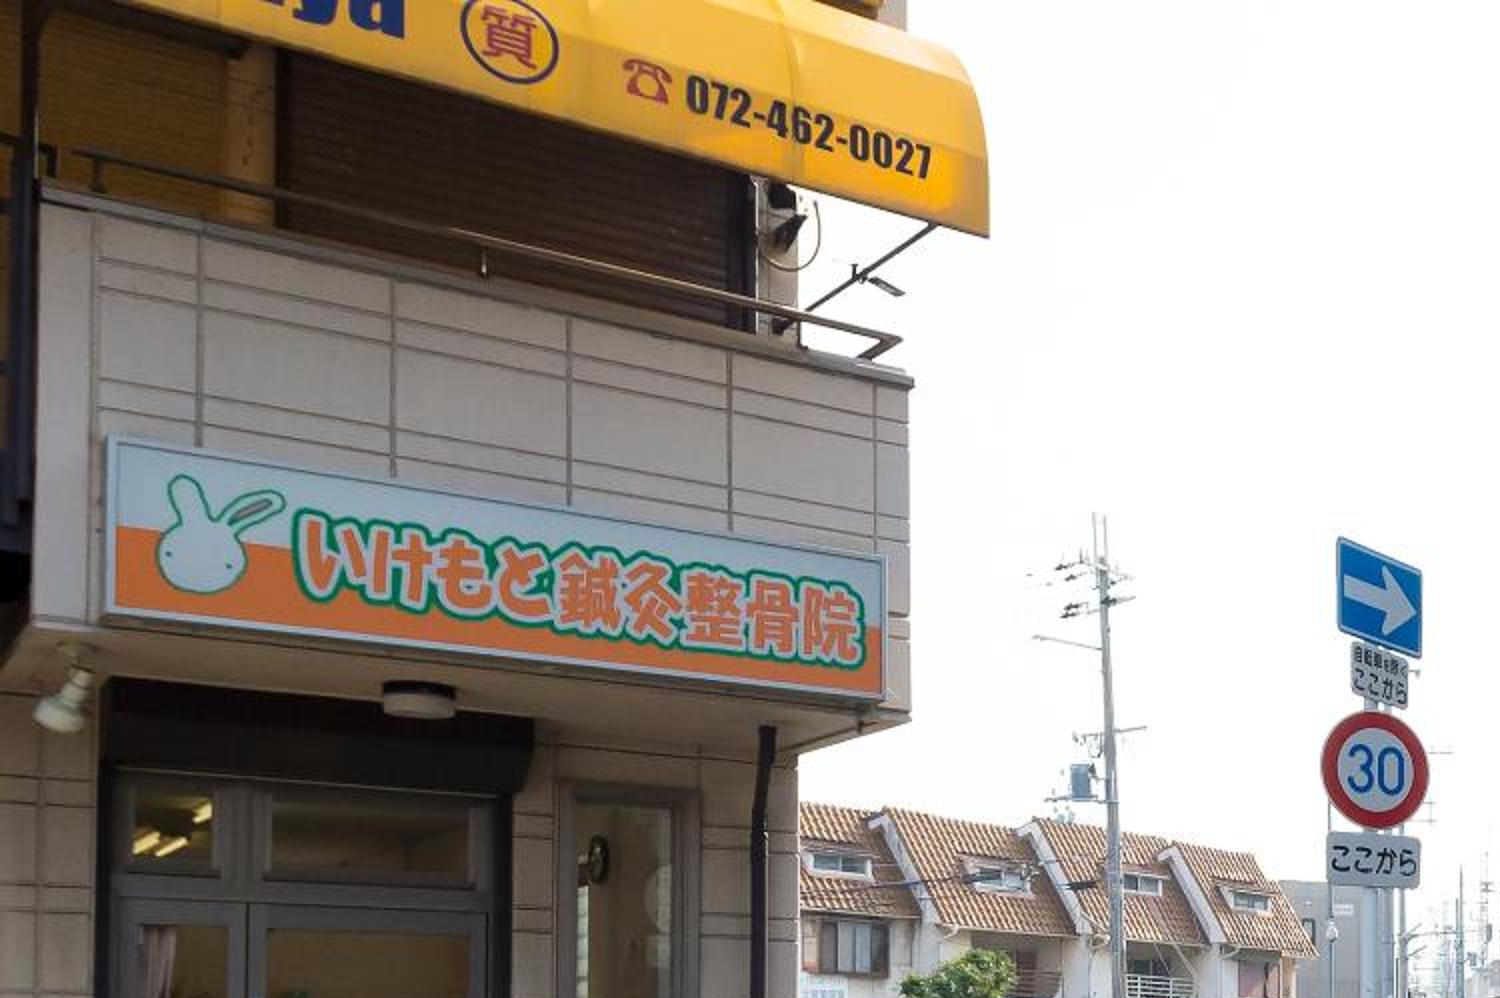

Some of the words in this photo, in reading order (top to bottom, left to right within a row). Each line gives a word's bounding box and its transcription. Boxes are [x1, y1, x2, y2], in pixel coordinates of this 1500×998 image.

[479, 4, 538, 70] 質
[686, 75, 932, 179] 072-462-0027
[297, 513, 864, 666] いけもと鍼灸整骨院
[1353, 667, 1408, 705] ここから
[1348, 743, 1405, 796] 30
[1331, 845, 1417, 876] ここから
